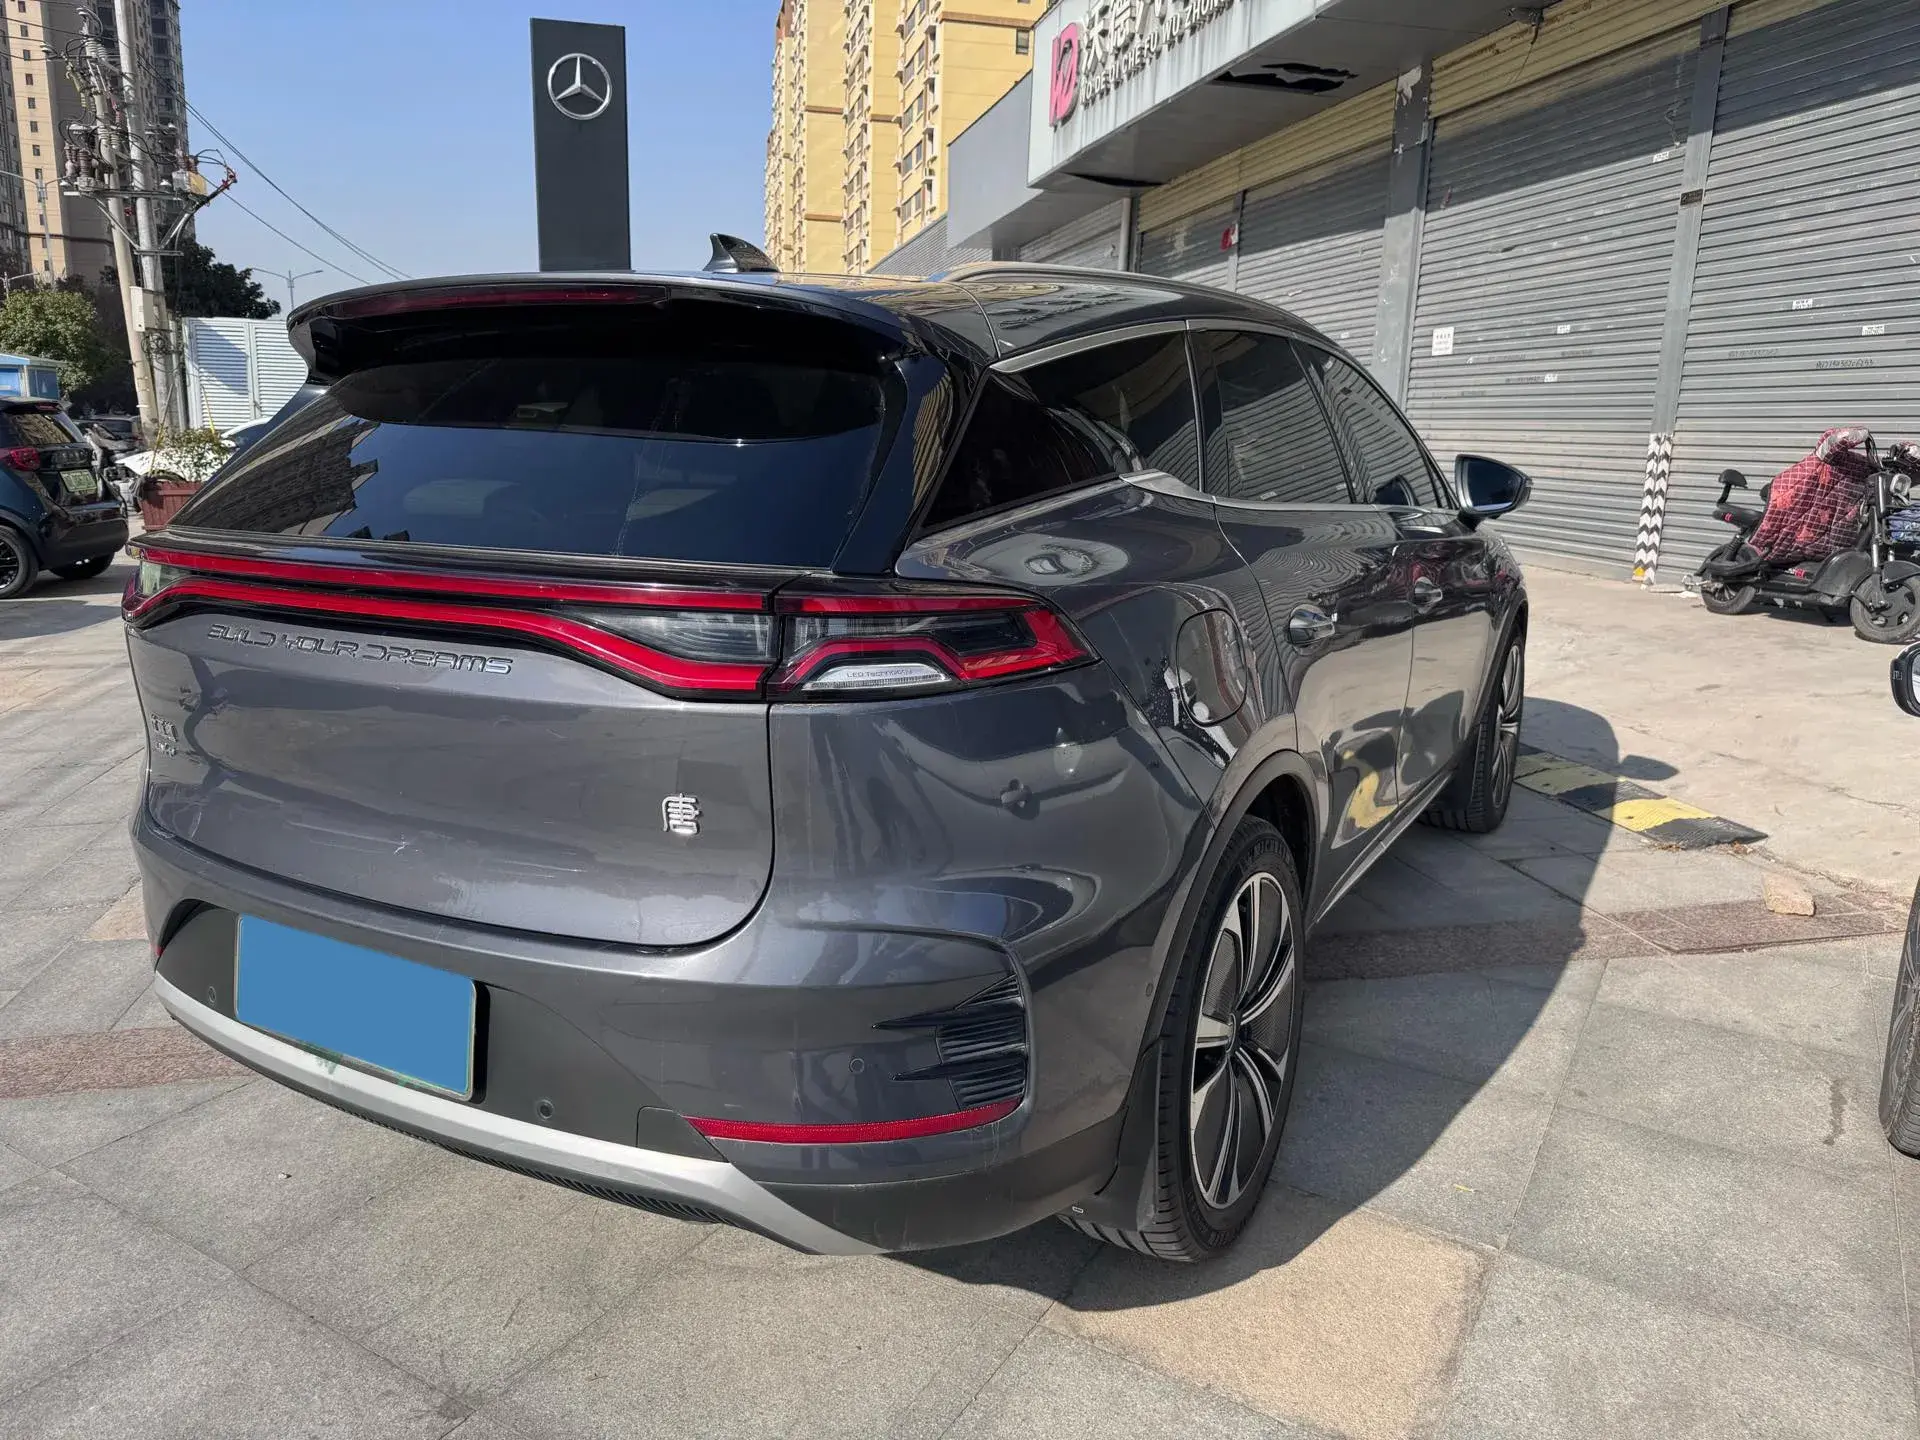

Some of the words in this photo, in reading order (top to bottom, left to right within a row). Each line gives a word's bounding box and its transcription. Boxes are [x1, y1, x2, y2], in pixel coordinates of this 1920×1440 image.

[1095, 70, 1106, 94] DE
[1122, 45, 1142, 75] CHE
[1144, 30, 1158, 57] FU
[1163, 12, 1180, 41] WU
[207, 623, 277, 648] BUILD
[282, 633, 360, 658] YOUR
[362, 643, 514, 675] DREAMS
